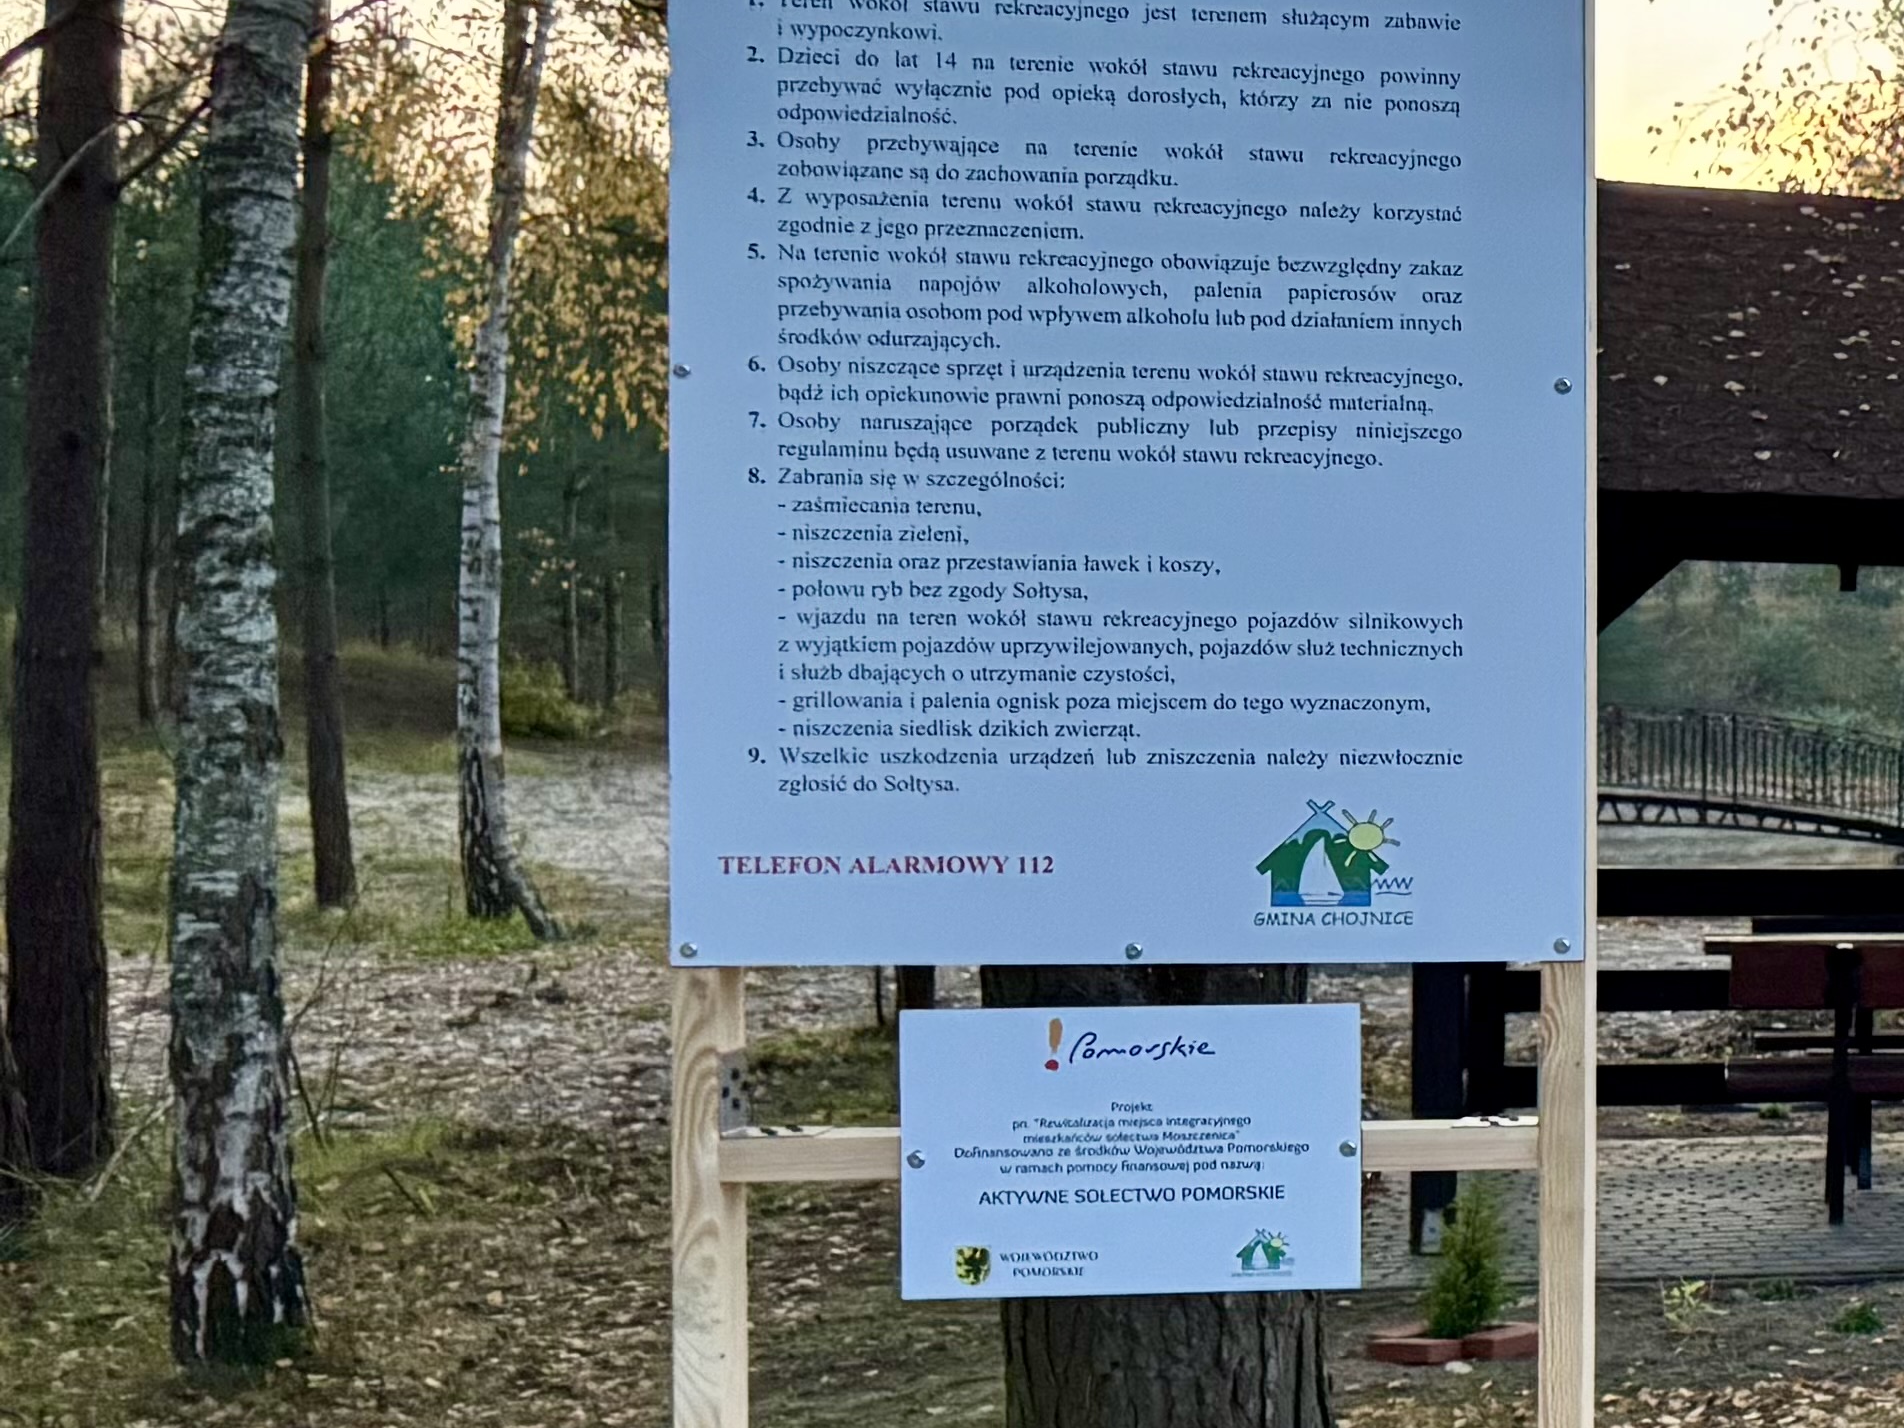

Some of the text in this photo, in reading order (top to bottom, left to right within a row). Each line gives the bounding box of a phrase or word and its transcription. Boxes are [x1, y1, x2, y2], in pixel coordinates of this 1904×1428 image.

[1141, 2, 1177, 25] jest
[1190, 7, 1268, 26] terenem
[1281, 7, 1370, 32] służącym
[1383, 11, 1462, 32] zabawie
[789, 20, 944, 44] wypoczynkowi.
[746, 45, 1462, 91] 2. Dzieci do lat 14 na terenie wokół stawu rekreacyjnego powinny
[776, 102, 958, 127] odpowiedzialność.
[747, 410, 1463, 445] 7. Osoby naruszające porządek publiczny lub przepisy niniejszego
[776, 438, 1384, 471] regulaminu będą usuwane z terenu wokół stawu rekreacyjnego.
[747, 466, 1066, 493] 8. Zabrania się w szczególności:
[791, 494, 911, 515] zaśmiecania
[914, 499, 983, 518] terenu,
[791, 522, 894, 543] niszczenia
[897, 523, 970, 546] zieleni,
[791, 550, 894, 570] niszczenia
[897, 556, 942, 571] oraz
[945, 553, 1078, 576] przestawiania
[1082, 553, 1141, 573] ławek
[1158, 555, 1222, 578] koszy,
[791, 578, 866, 603] połowu
[870, 579, 904, 602] ryb
[908, 579, 944, 599] bez
[947, 580, 1008, 604] zgody
[1012, 580, 1089, 604] Sołtysa,
[796, 606, 867, 631] wjazdu
[875, 612, 900, 627] na
[908, 610, 958, 627] teren
[966, 608, 1027, 628] wokół
[1036, 611, 1093, 628] stawu
[1102, 609, 1238, 633] rekreacyjnego
[1247, 610, 1340, 635] pojazdów
[1347, 611, 1464, 635] silnikowych
[777, 634, 1464, 662] z wyjątkiem pojazdów uprzywilejowanych, pojazdów służ technicznych
[790, 661, 844, 682] służb
[847, 662, 946, 687] dbających
[951, 668, 965, 682] o
[969, 663, 1078, 687] utrzymanie
[1082, 664, 1176, 687] czystości,
[791, 690, 904, 714] grillowania
[921, 690, 991, 715] palenia
[995, 691, 1061, 714] ognisk
[1065, 695, 1112, 715] poza
[1116, 691, 1208, 715] miejscem
[1212, 692, 1238, 711] do
[1242, 695, 1285, 716] tego
[1289, 697, 1432, 716] wyznaczonym,
[792, 717, 894, 738] niszczenia
[898, 718, 974, 738] siedlisk
[977, 718, 1050, 738] dzikich
[1053, 718, 1142, 744] zwierząt.
[747, 745, 1464, 771] 9. Wszelkie uszkodzenia urządzeń lub zniszczenia należy niezwłocznie
[777, 773, 961, 797] zgłosić do Sołtysa.
[716, 855, 1054, 876] TELEFON ALARMOWY 112
[1252, 910, 1414, 927] GMINA CHOJNICE
[1068, 1030, 1217, 1065] Pomorskie
[1110, 1100, 1154, 1115] Projekt
[1117, 1117, 1164, 1130] miejsca
[1165, 1115, 1253, 1130] integracyjnego
[953, 1140, 1311, 1160] Dofinansowano ze środków Województwa Pomorskiego
[998, 1164, 1014, 1176] w
[1014, 1161, 1065, 1175] ramach
[1065, 1162, 1119, 1176] pomocy
[1120, 1158, 1191, 1174] finansowej
[1192, 1157, 1218, 1174] pod
[977, 1188, 1070, 1207] AKTYWNE
[1180, 1183, 1286, 1203] POMORSKIE
